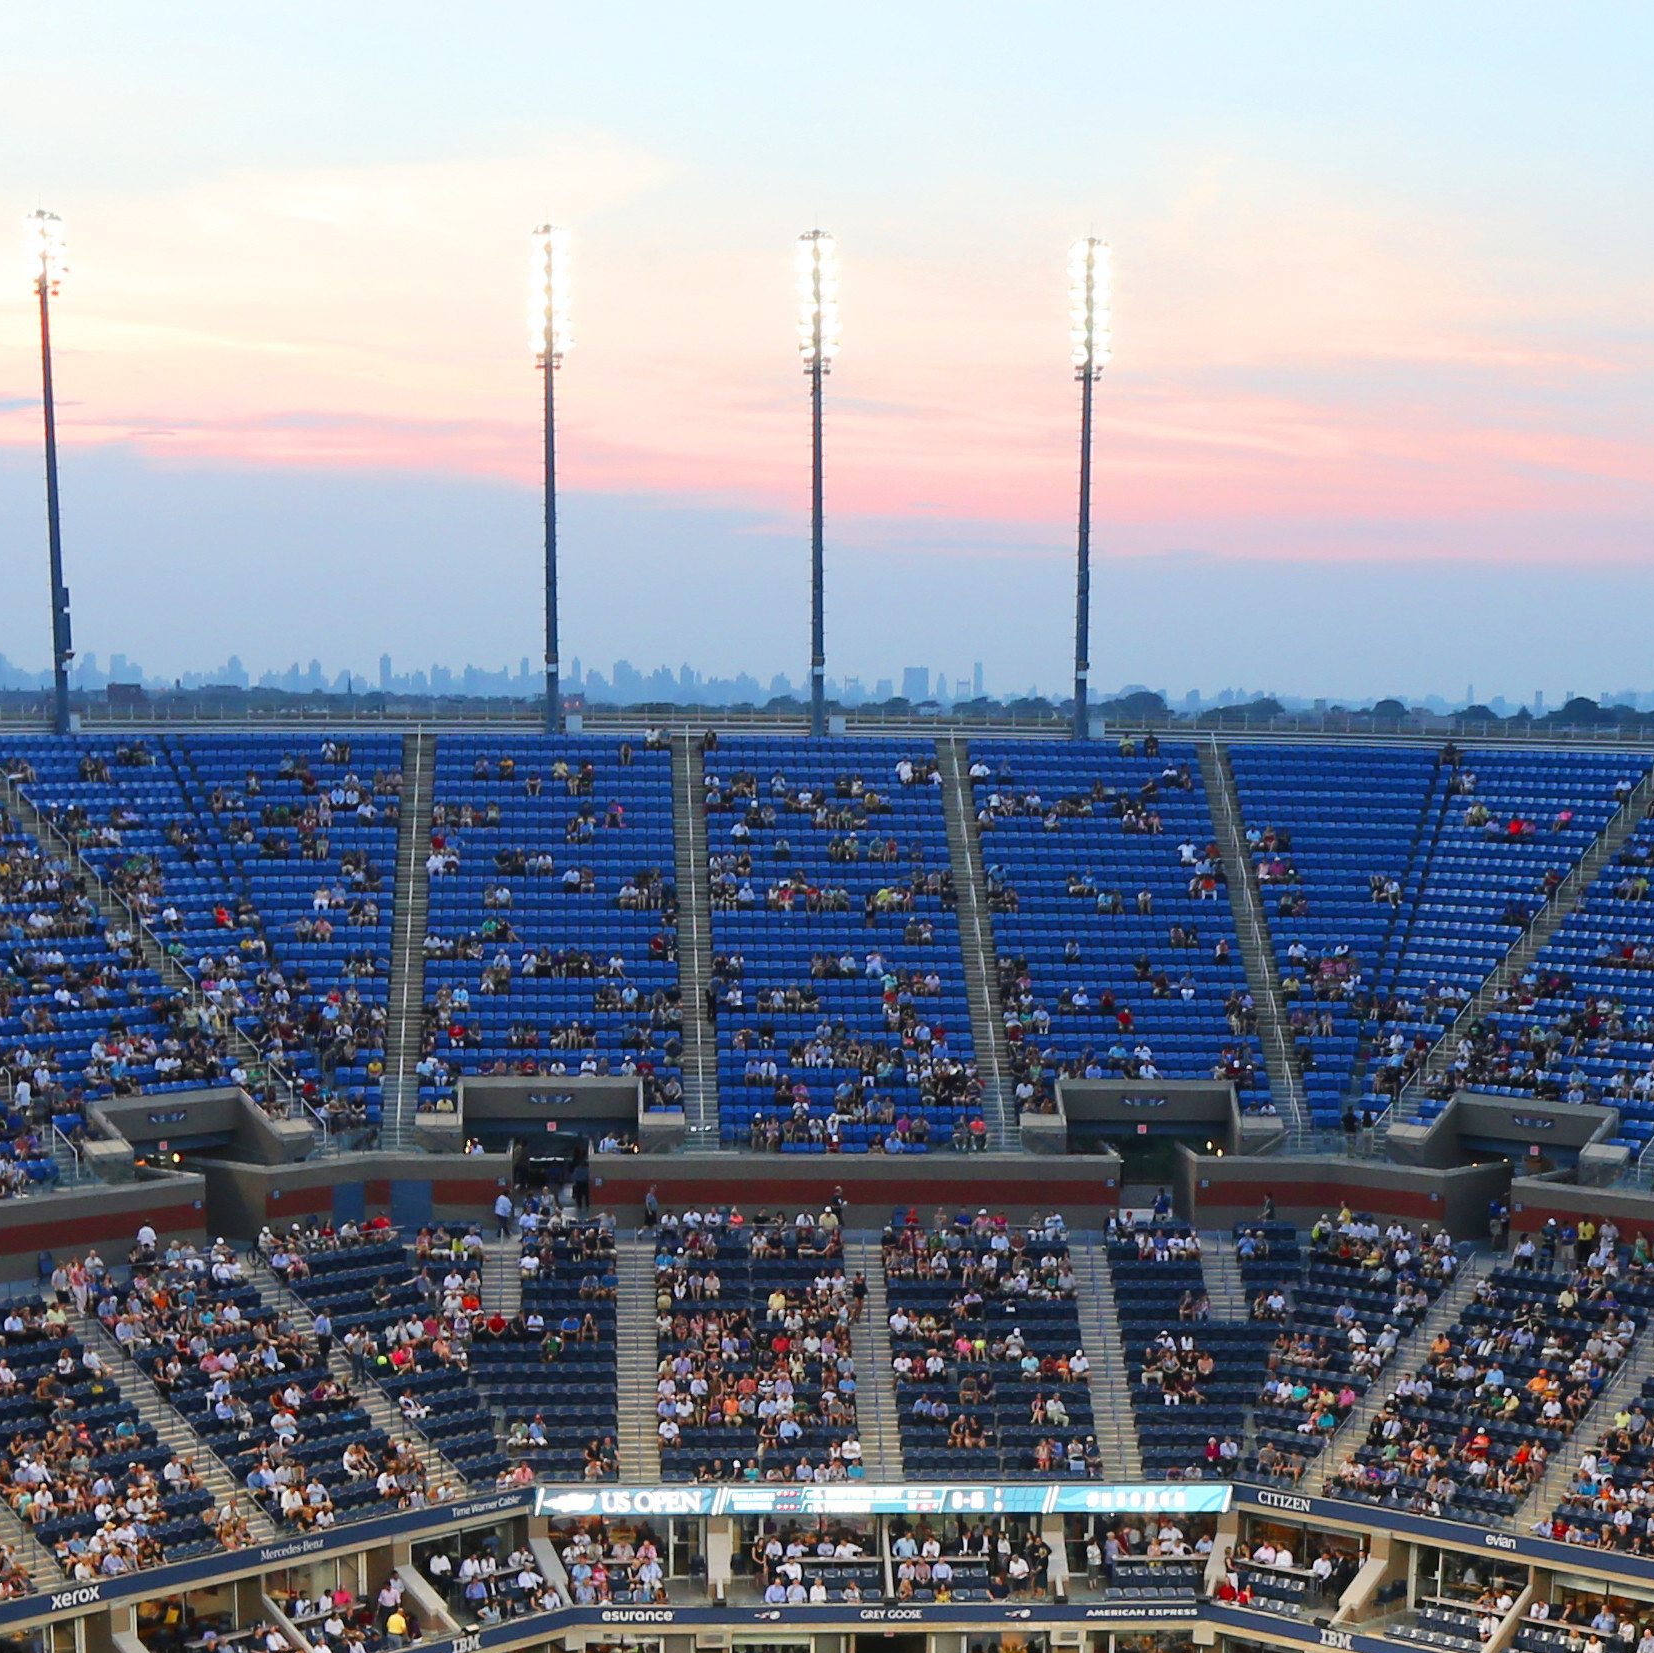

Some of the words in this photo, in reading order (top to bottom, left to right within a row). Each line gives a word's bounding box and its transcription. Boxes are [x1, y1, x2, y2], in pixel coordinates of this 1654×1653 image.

[600, 1491, 632, 1512] US
[634, 1490, 702, 1514] OPEN
[1257, 1490, 1311, 1512] CITIZEN
[260, 1538, 324, 1561] Mercedes-Benz
[1485, 1534, 1516, 1550] evian
[51, 1585, 100, 1611] xerox
[602, 1610, 673, 1623] esurance
[860, 1610, 886, 1620] GREY
[890, 1610, 922, 1620] GOOSE
[1085, 1609, 1144, 1617] AMERICAN
[1148, 1608, 1199, 1617] EXPRESS
[1319, 1629, 1353, 1649] IBM
